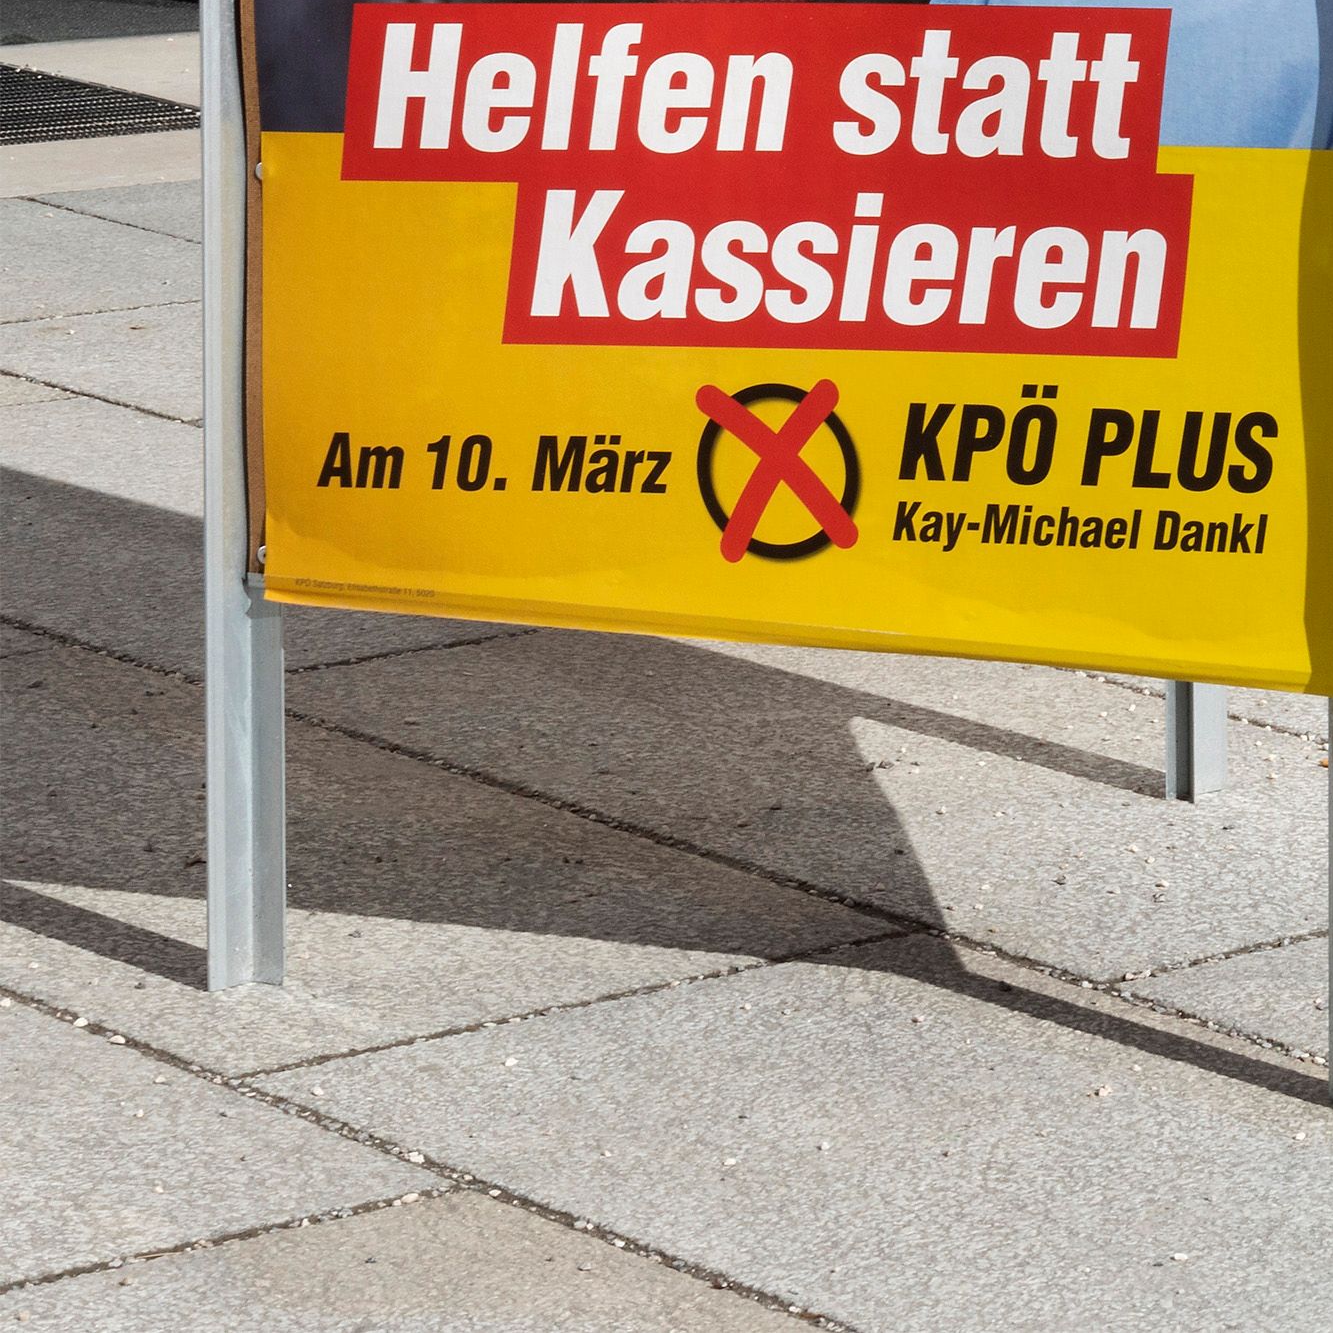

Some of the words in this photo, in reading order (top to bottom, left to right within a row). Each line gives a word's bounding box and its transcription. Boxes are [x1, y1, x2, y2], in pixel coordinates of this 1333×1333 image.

[374, 23, 793, 153] Helfen
[833, 30, 1139, 159] statt
[531, 190, 1166, 328] Kassieren
[317, 433, 404, 489] Am
[427, 435, 506, 491] 10.
[532, 435, 671, 493] März
[899, 385, 1058, 485] KPÖ
[1081, 409, 1278, 493] PLUS
[893, 502, 1139, 552] Kay-Michael
[1154, 511, 1268, 553] Dankl
